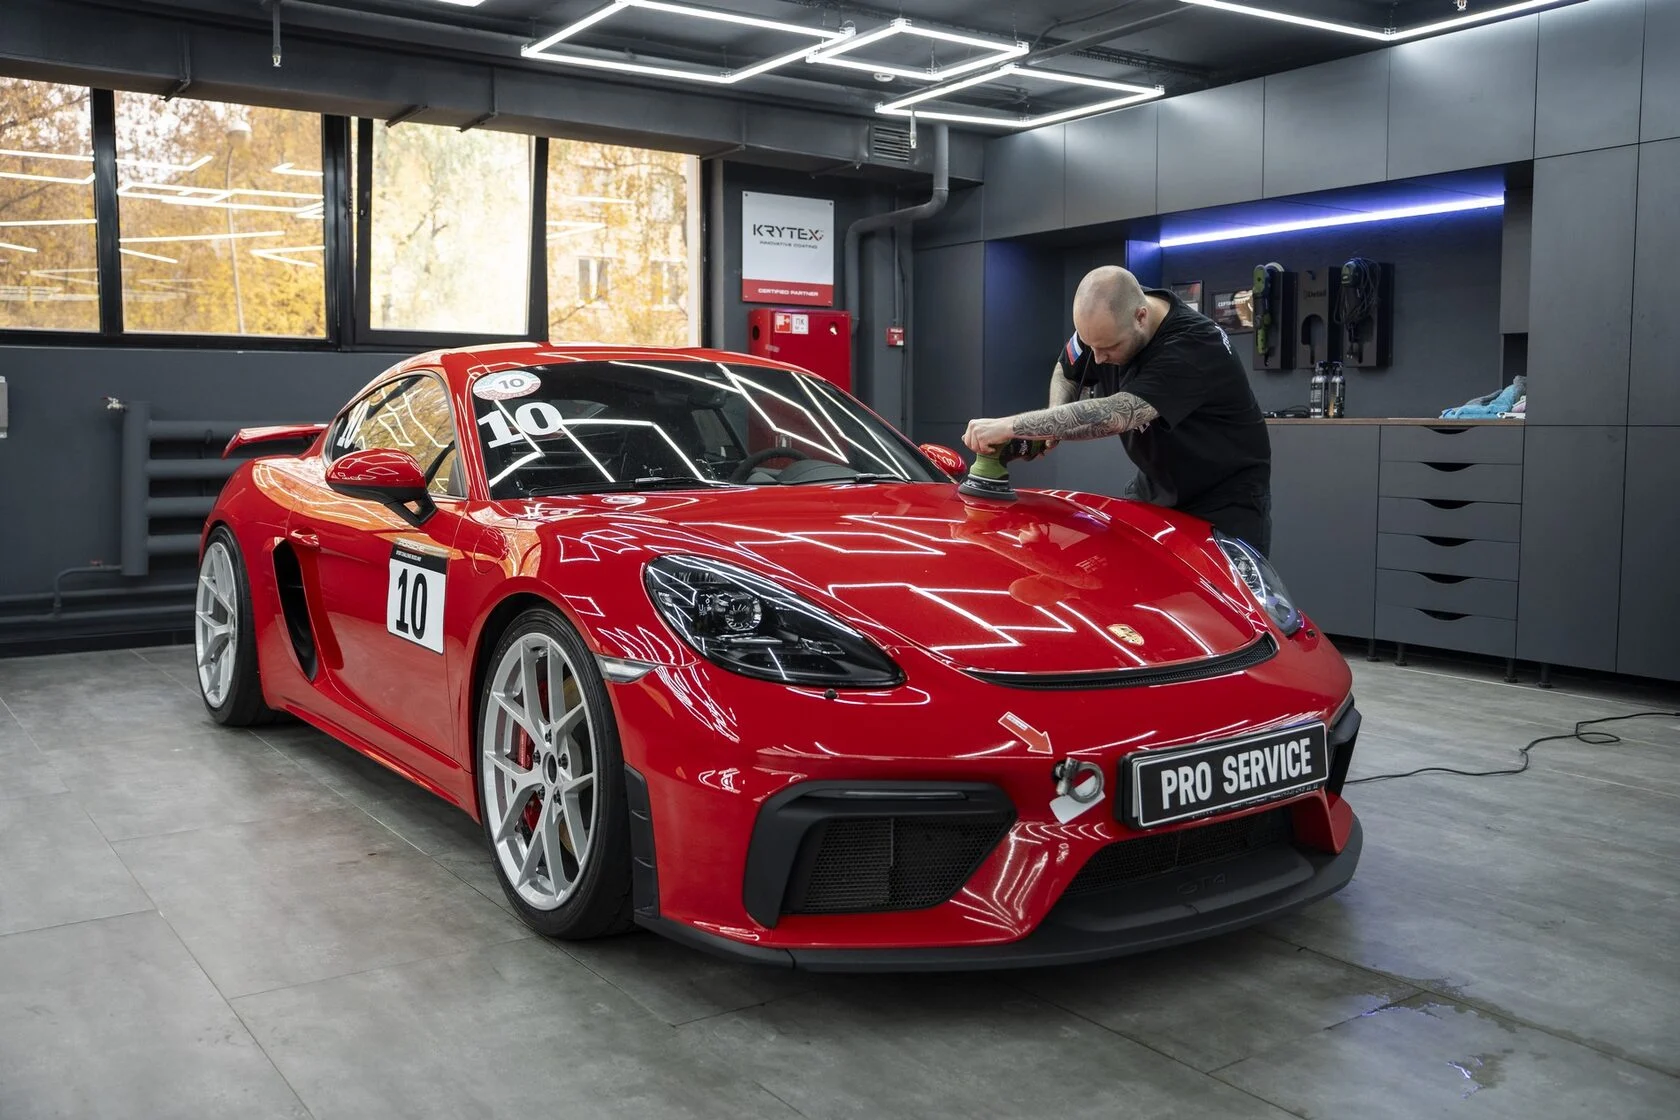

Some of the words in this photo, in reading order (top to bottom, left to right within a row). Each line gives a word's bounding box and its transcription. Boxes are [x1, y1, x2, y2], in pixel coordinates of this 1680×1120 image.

[753, 224, 820, 241] KRYTEX
[499, 379, 525, 389] 10
[477, 402, 563, 449] 10
[396, 568, 428, 640] 10
[1160, 761, 1212, 810] PRO
[1222, 737, 1312, 794] SERVICE
